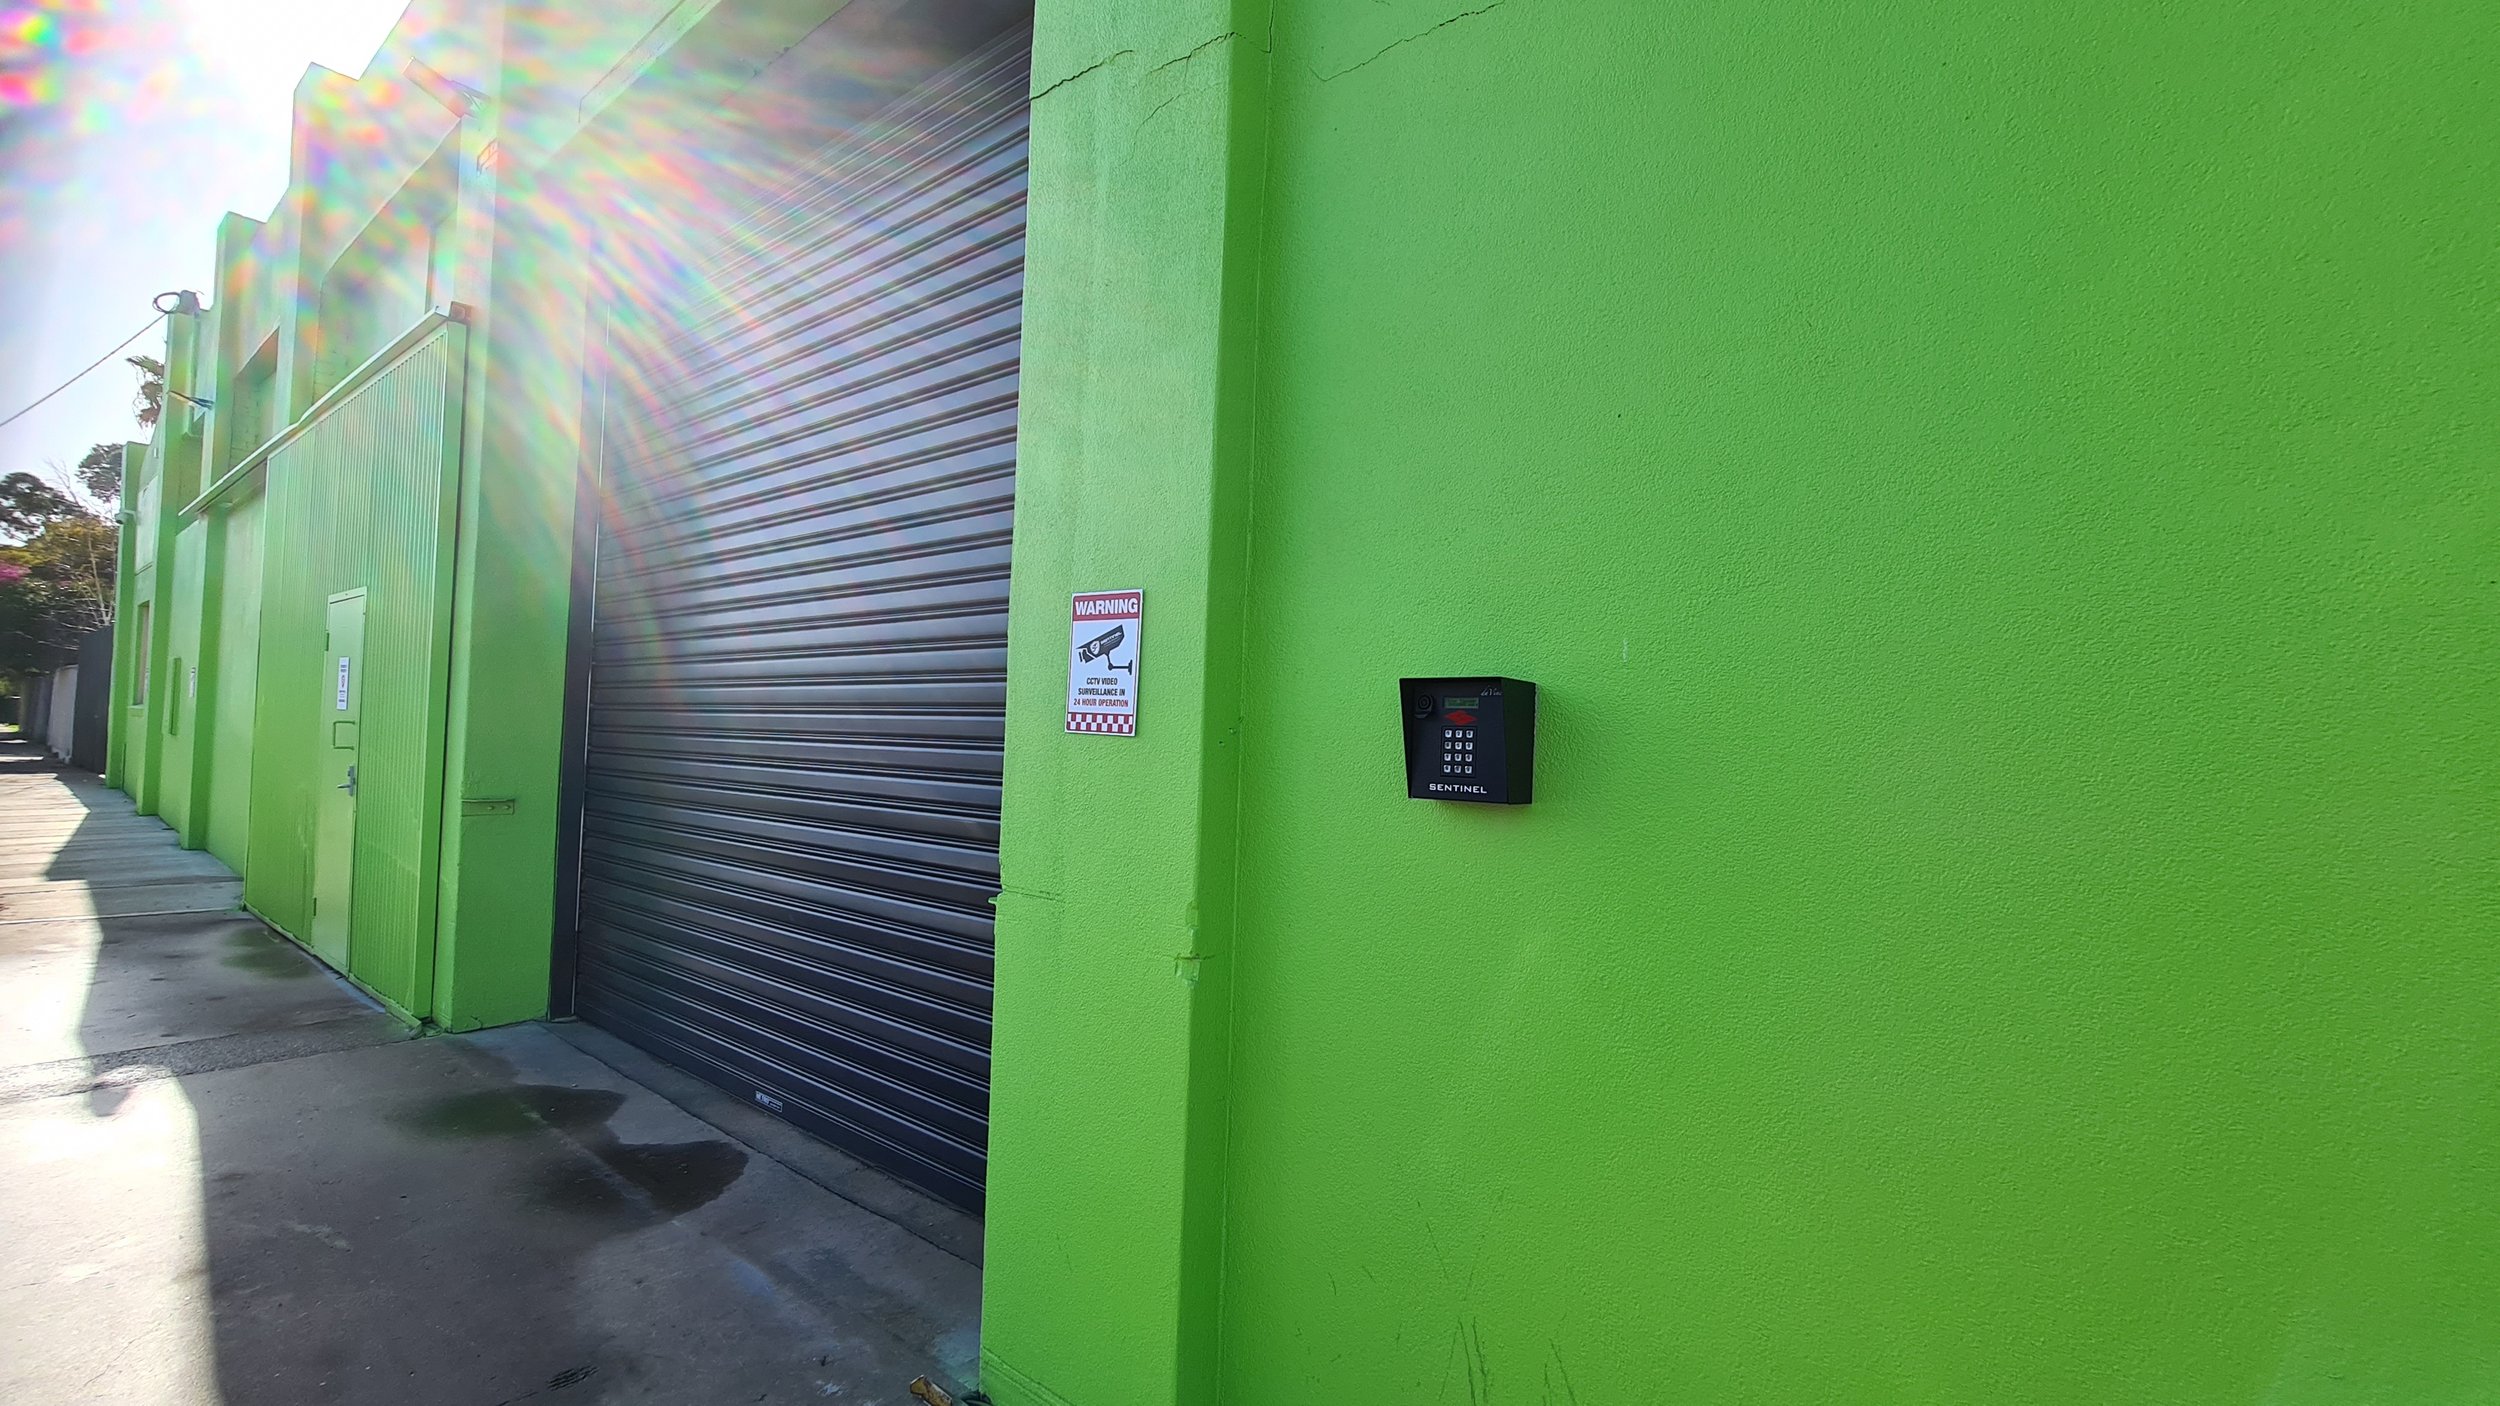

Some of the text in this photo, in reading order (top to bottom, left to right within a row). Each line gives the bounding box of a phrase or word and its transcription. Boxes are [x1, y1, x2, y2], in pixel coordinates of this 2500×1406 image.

[1075, 598, 1138, 616] WARNING
[1086, 677, 1118, 686] CCTV VIDEO
[1078, 688, 1126, 697] SURVEILLANCE IN
[1073, 698, 1129, 708] 24 HOUR OPERATION
[1429, 783, 1488, 794] SENTINEL
